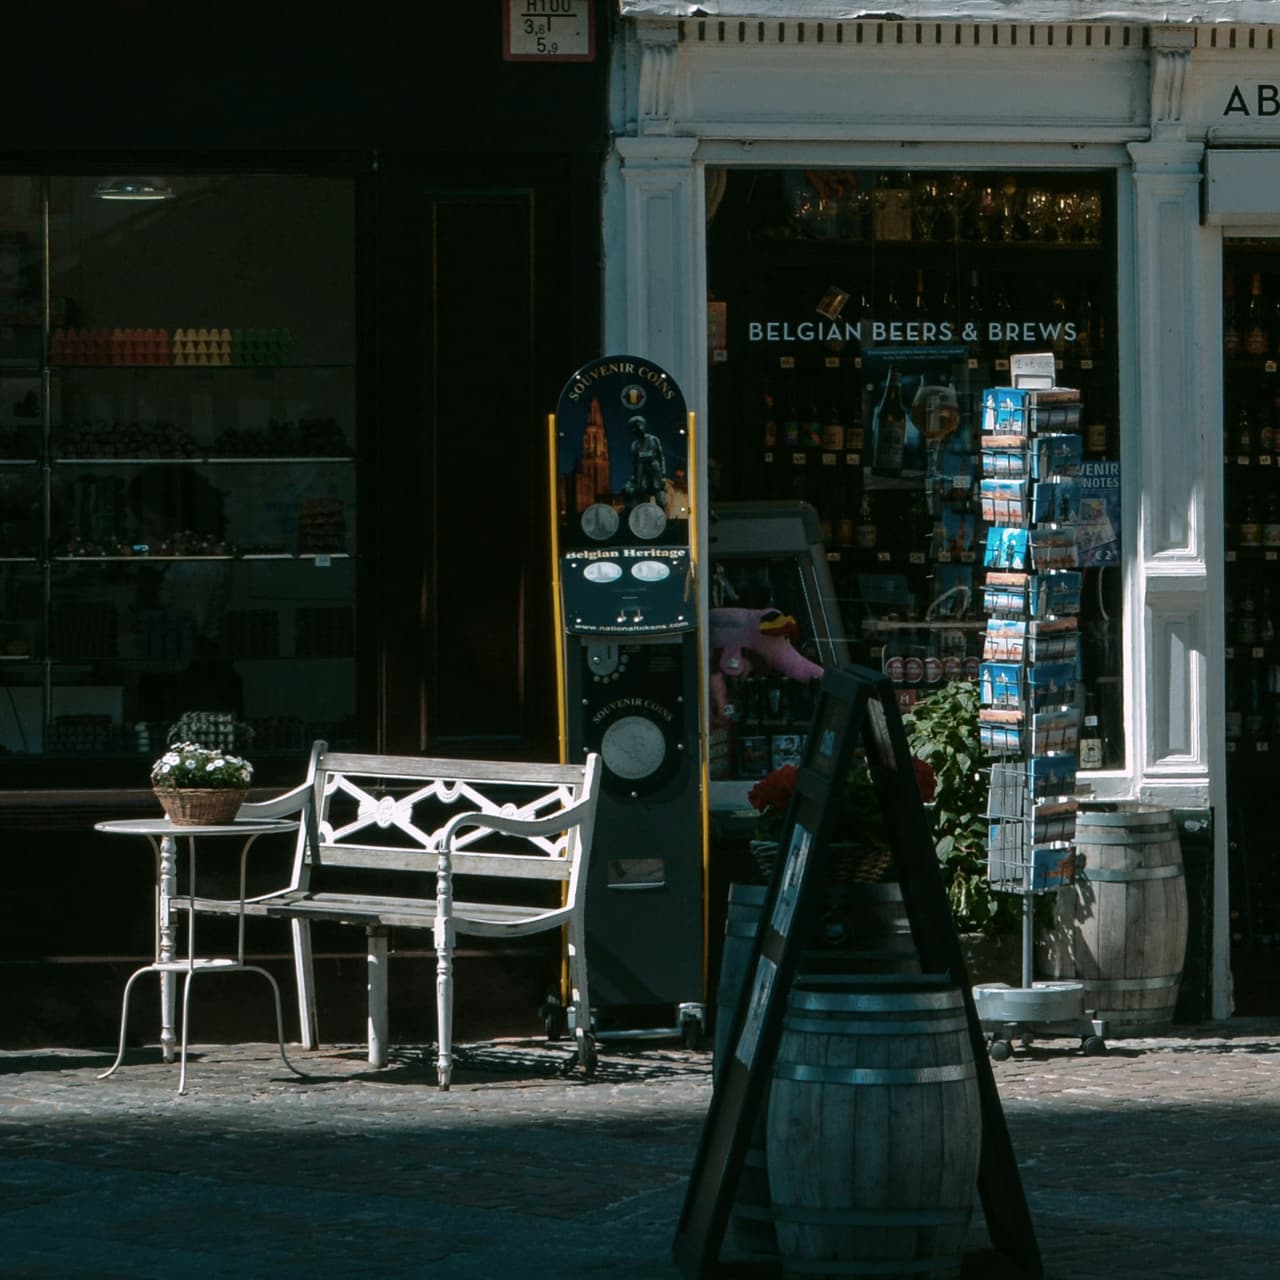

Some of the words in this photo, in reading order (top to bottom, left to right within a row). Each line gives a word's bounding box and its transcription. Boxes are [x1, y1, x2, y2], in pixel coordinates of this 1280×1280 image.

[748, 322, 862, 341] BELGIAN
[872, 322, 953, 342] BEERS
[961, 322, 979, 341] &
[989, 322, 1078, 342] BREWS
[569, 363, 635, 401] SOUVENIR
[638, 366, 675, 400] COINS
[565, 549, 619, 561] Belgian
[623, 548, 686, 559] Heritage
